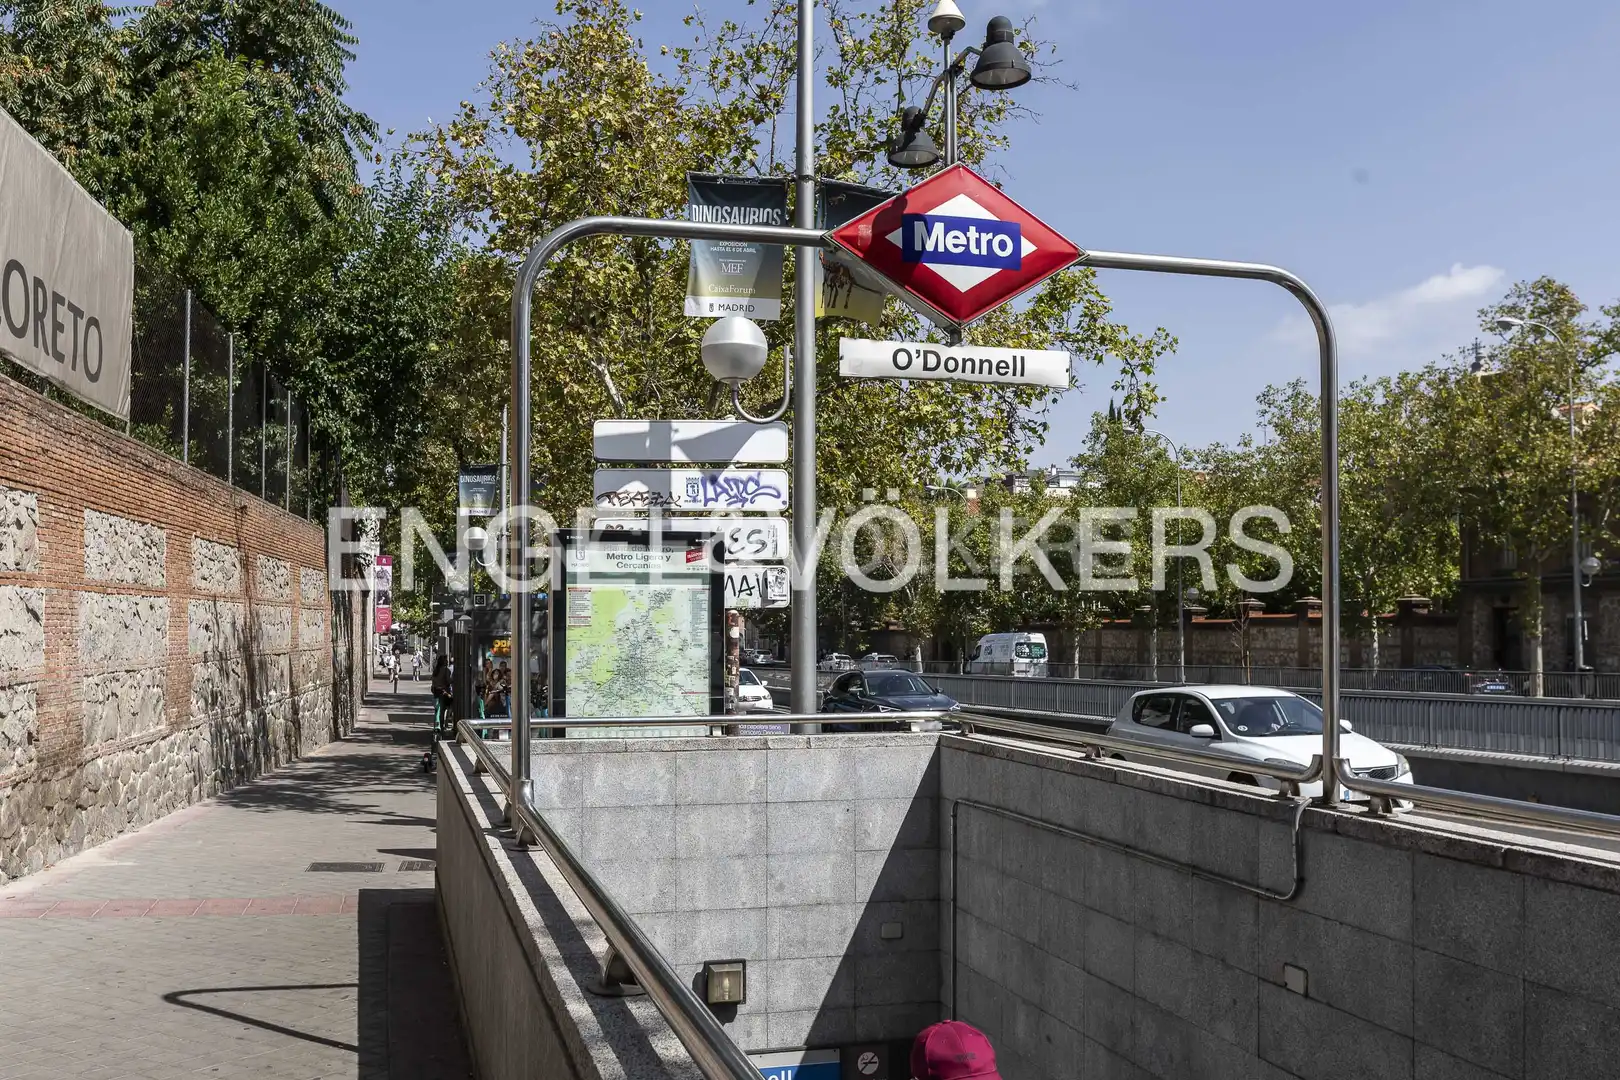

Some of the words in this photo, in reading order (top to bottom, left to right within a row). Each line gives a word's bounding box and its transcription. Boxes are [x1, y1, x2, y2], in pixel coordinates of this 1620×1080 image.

[692, 204, 781, 225] DINOSAURIOS
[913, 220, 1014, 258] Metro
[721, 262, 744, 274] MEF
[708, 283, 756, 295] CaixaForum
[718, 303, 756, 313] MADRID
[0, 258, 104, 384] ORETO
[891, 347, 1026, 378] O'Donnell
[635, 553, 664, 562] Ligero
